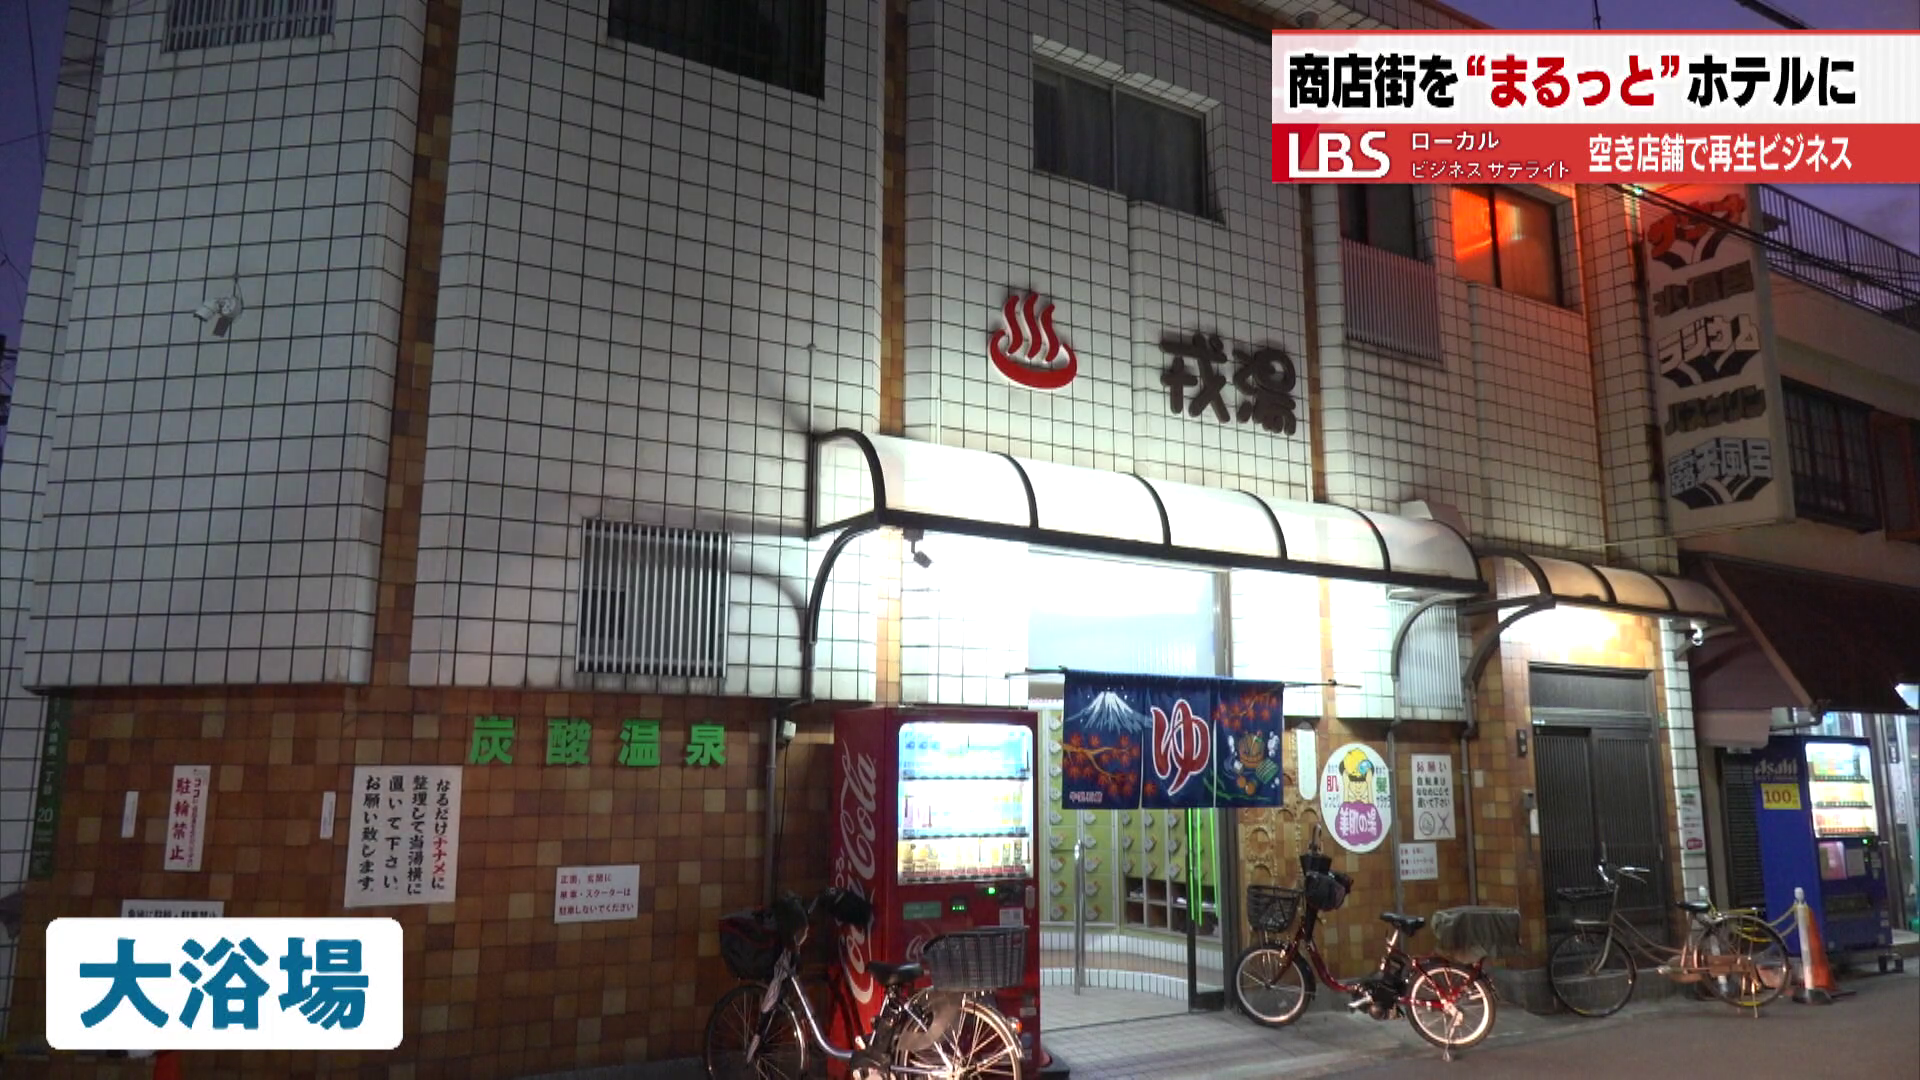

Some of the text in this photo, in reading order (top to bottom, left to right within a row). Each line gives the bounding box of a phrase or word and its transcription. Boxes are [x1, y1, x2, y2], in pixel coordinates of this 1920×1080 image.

[1657, 313, 1762, 378] ラジウム
[1158, 333, 1297, 436] 戎湯
[468, 715, 728, 768] 炭酸温泉
[1150, 699, 1211, 797] ゆ
[1754, 758, 1799, 775] Asahi
[1326, 775, 1339, 793] 肌
[1416, 777, 1447, 787] 自転車は
[1764, 789, 1792, 804] 100
[37, 808, 53, 823] 20
[169, 777, 192, 861] 駐輪禁止
[407, 774, 429, 896] 整理して当湯横に
